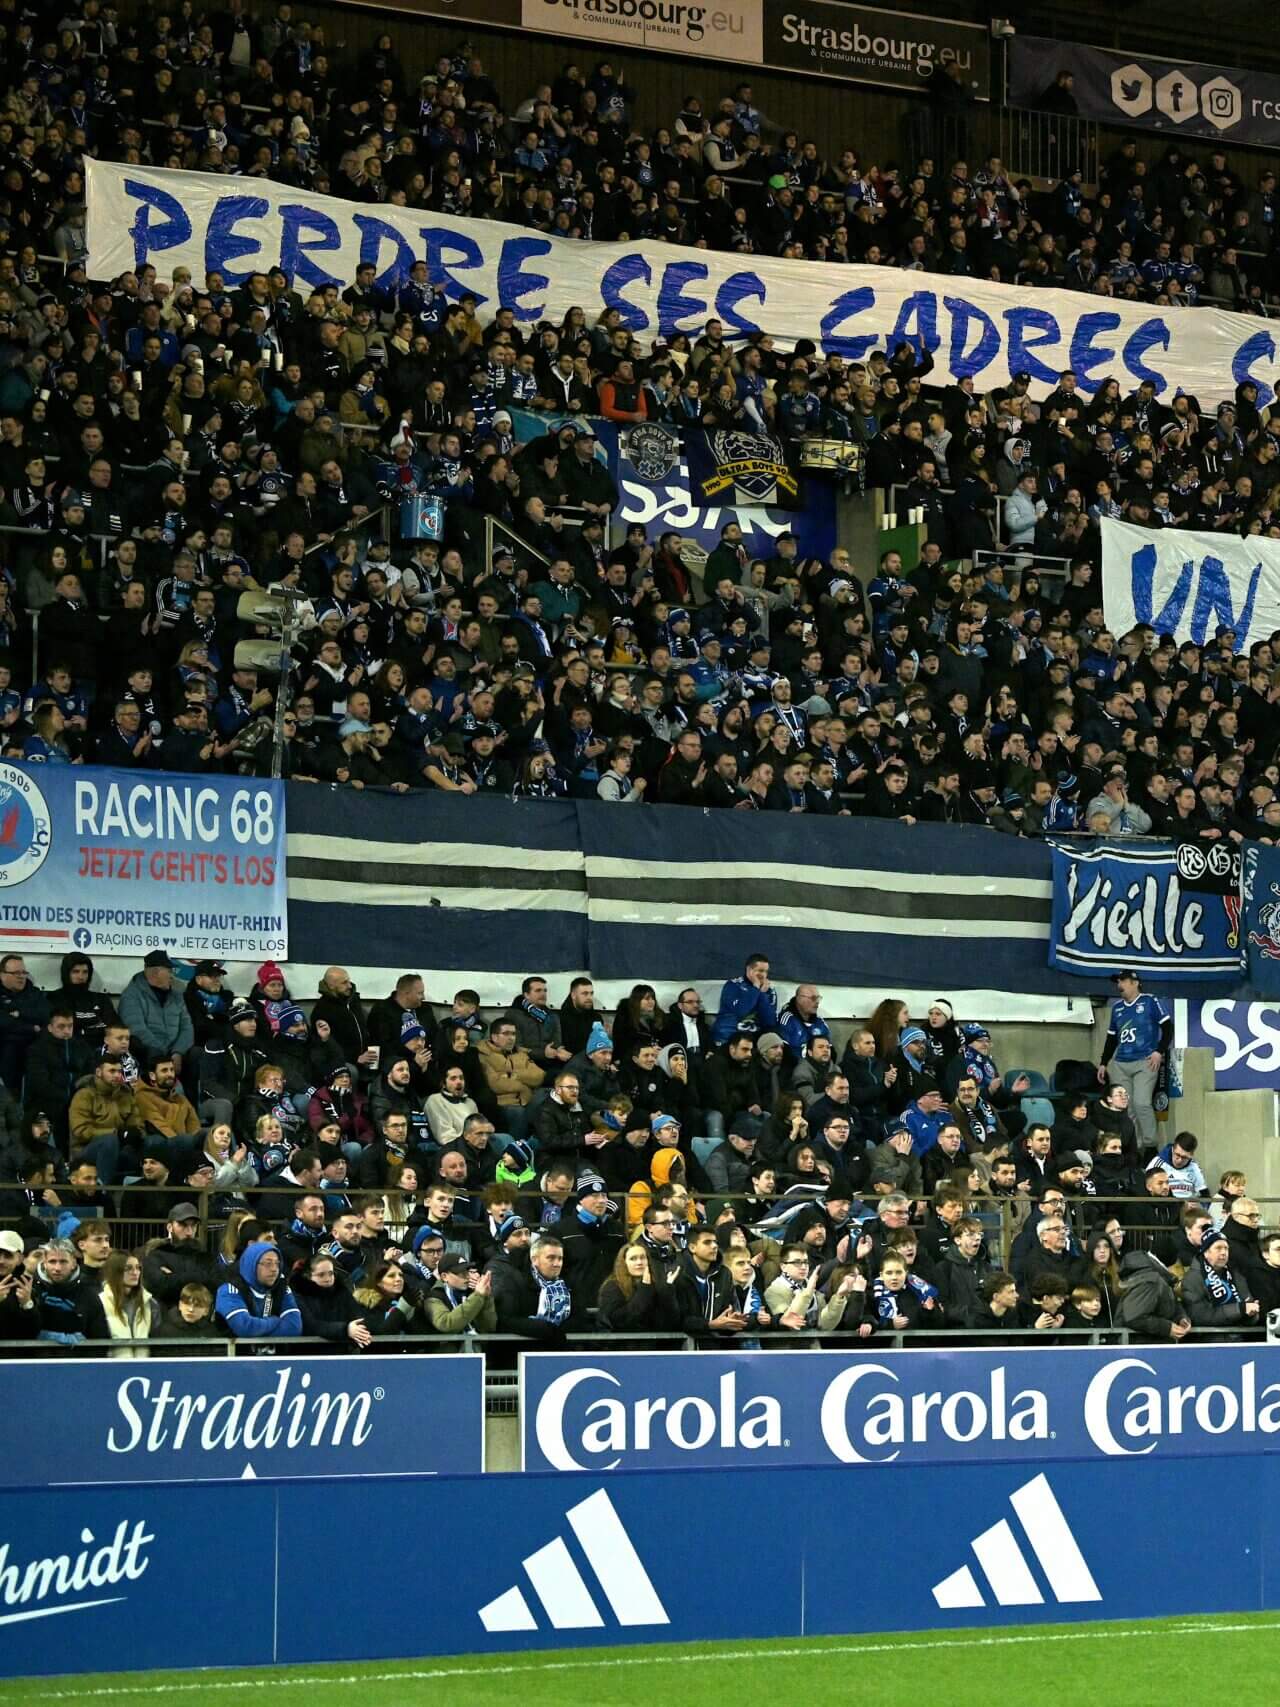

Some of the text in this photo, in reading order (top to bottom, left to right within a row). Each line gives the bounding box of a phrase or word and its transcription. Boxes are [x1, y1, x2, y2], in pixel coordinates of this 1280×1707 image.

[781, 13, 972, 77] Strasbourg.eu
[125, 179, 552, 318] PERDRE
[600, 253, 766, 340] SES
[1132, 544, 1262, 655] UN
[3, 768, 31, 793] 1906
[75, 779, 275, 846] RACING 68
[79, 846, 276, 887] JETZT GEHT'S LOS
[46, 906, 73, 924] DES
[77, 908, 170, 928] SUPPORTERS
[175, 912, 195, 929] DU
[199, 913, 282, 932] HAUT-RHIN
[1064, 864, 1204, 953] Vieille
[95, 932, 286, 951] RACING 68 JETZ GEHT'S LOS
[1120, 1027, 1137, 1043] es
